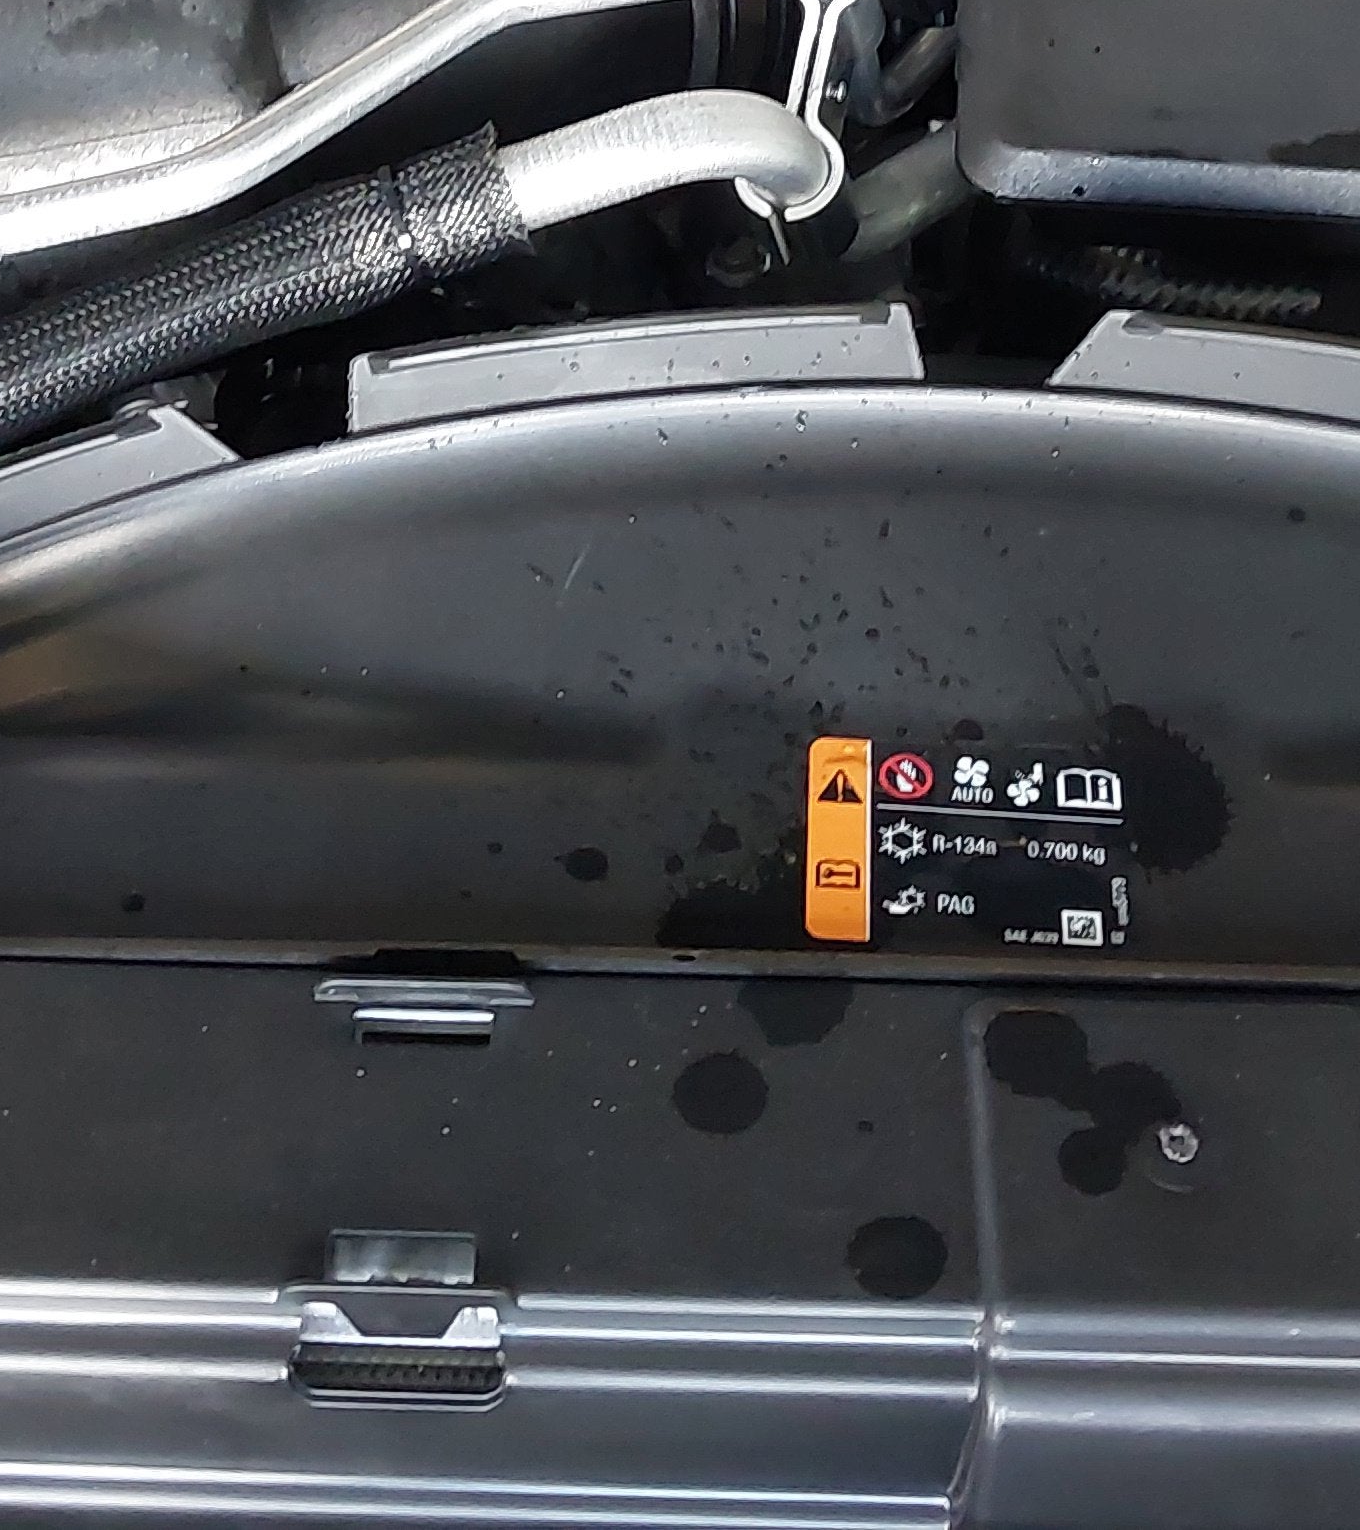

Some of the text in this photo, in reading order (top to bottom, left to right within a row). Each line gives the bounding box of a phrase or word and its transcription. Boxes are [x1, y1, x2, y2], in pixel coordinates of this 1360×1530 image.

[951, 786, 994, 804] AUTO
[932, 833, 1107, 866] R-134a 0.700 kg
[937, 893, 976, 915] PAG
